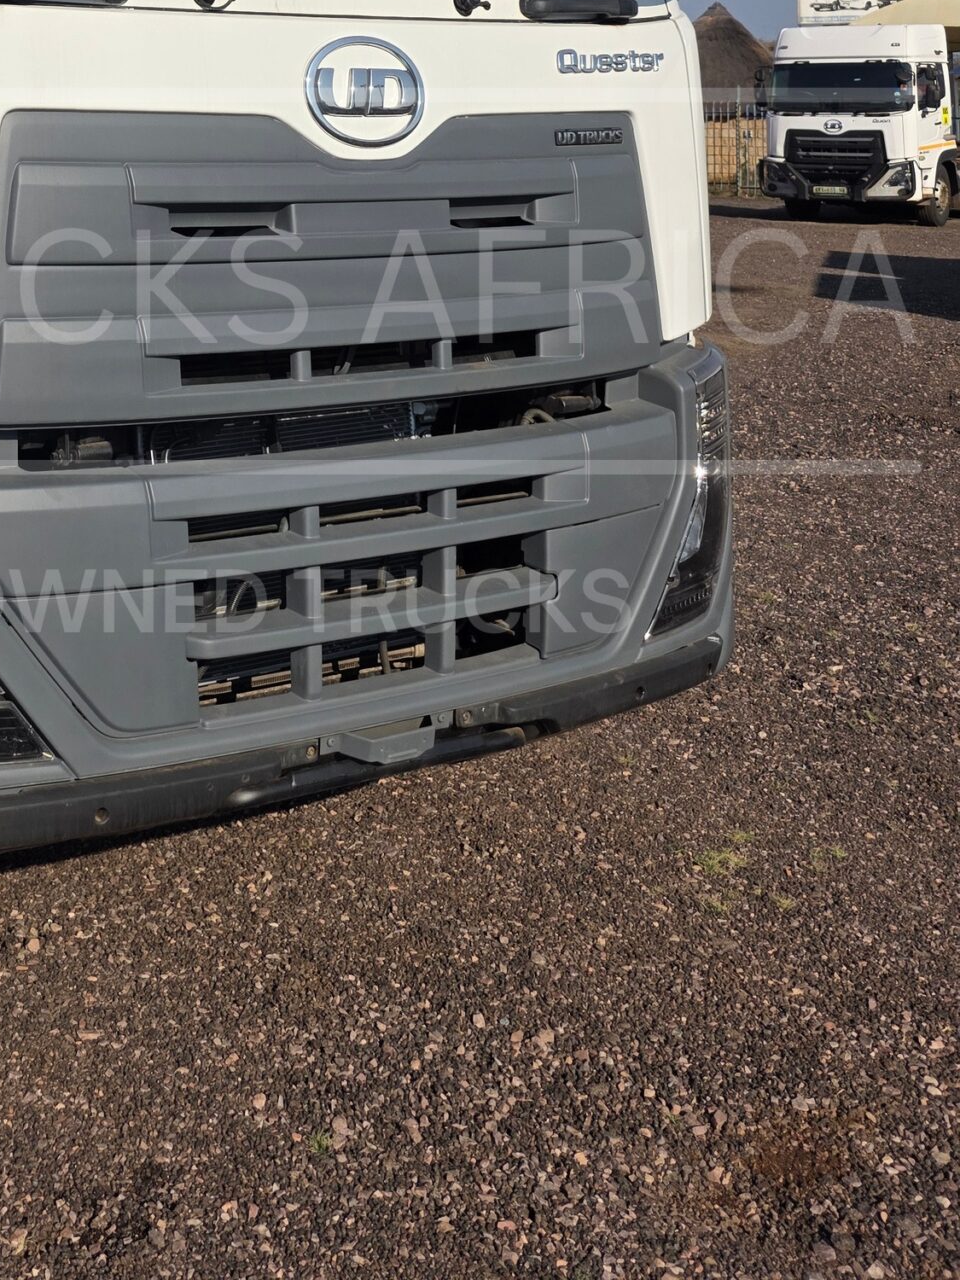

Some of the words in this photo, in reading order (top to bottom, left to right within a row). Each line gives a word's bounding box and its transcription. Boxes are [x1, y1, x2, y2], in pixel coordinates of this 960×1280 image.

[556, 48, 664, 74] Quester
[558, 131, 577, 144] UD
[578, 129, 624, 144] TRUCKS
